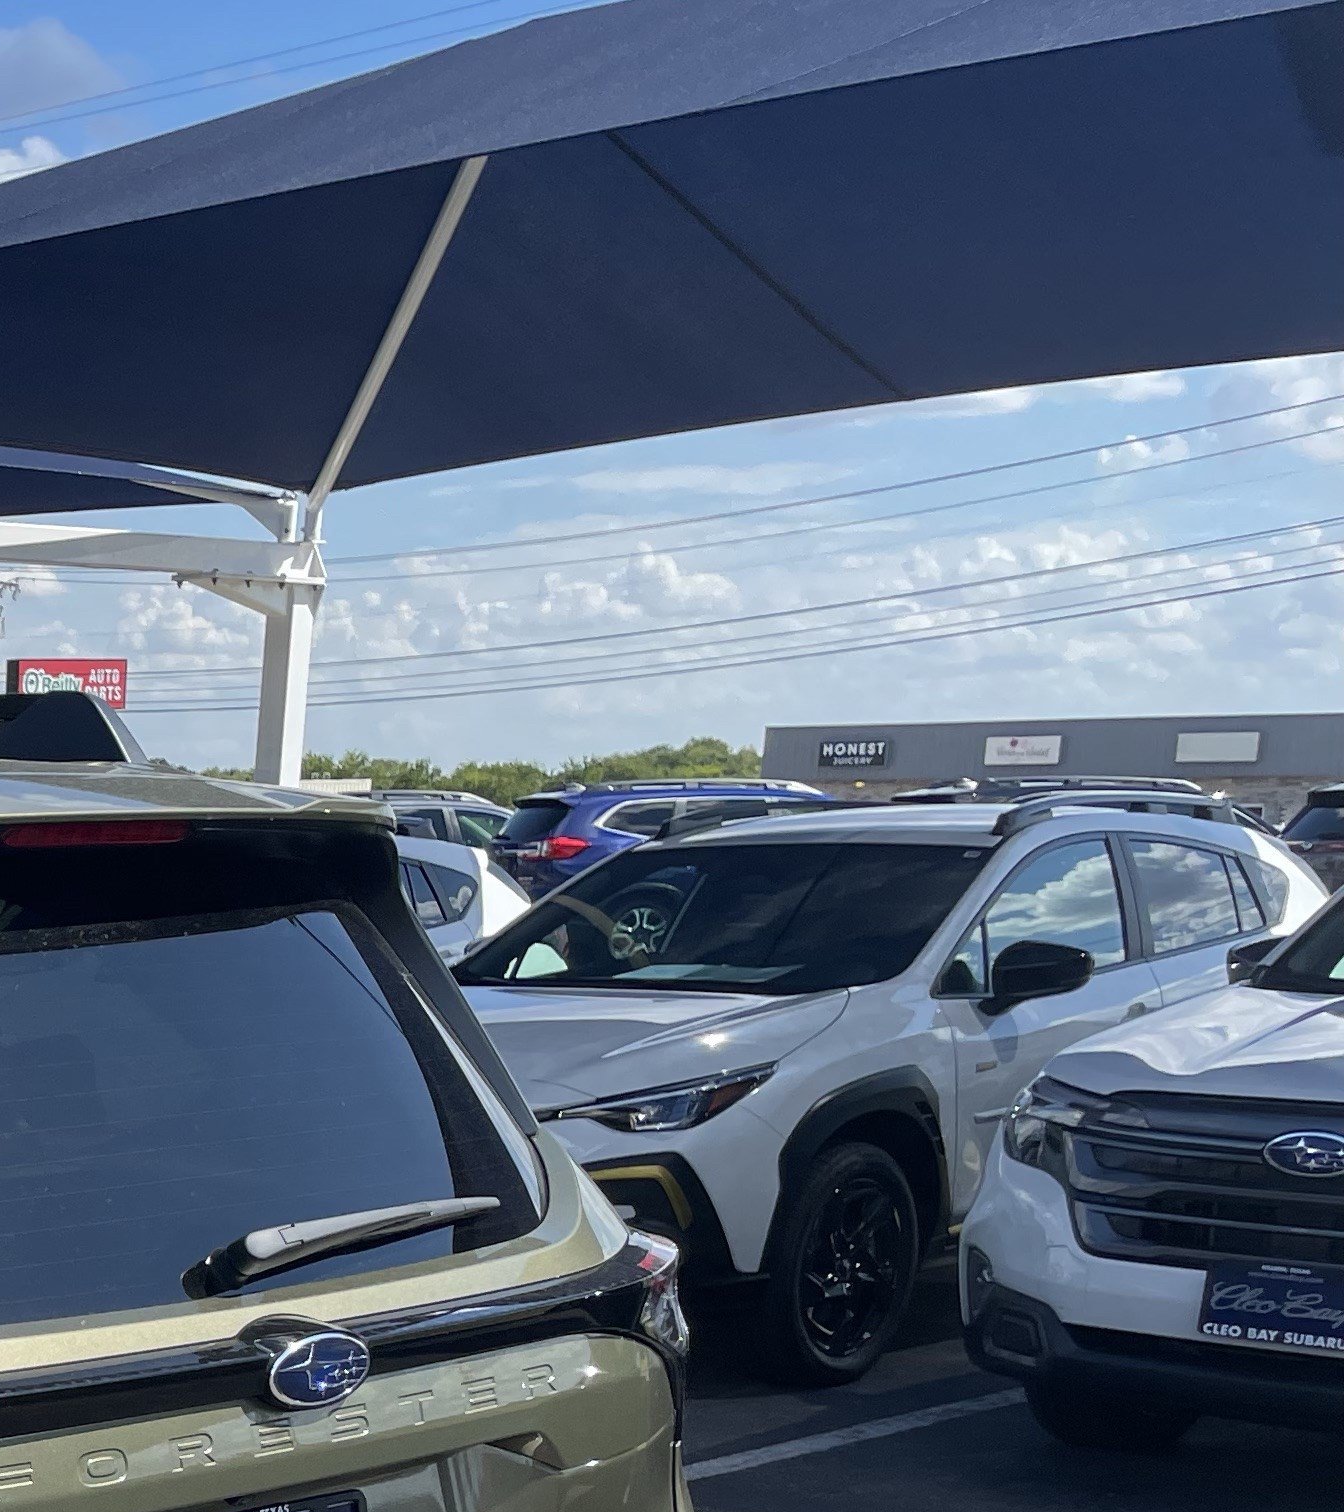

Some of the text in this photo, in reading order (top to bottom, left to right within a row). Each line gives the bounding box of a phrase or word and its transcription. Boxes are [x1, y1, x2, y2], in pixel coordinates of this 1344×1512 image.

[24, 668, 82, 694] O'Reilly
[89, 668, 121, 685] AUTO
[822, 742, 886, 757] HONEST
[1202, 1322, 1344, 1350] CLEO BAY SUBARU
